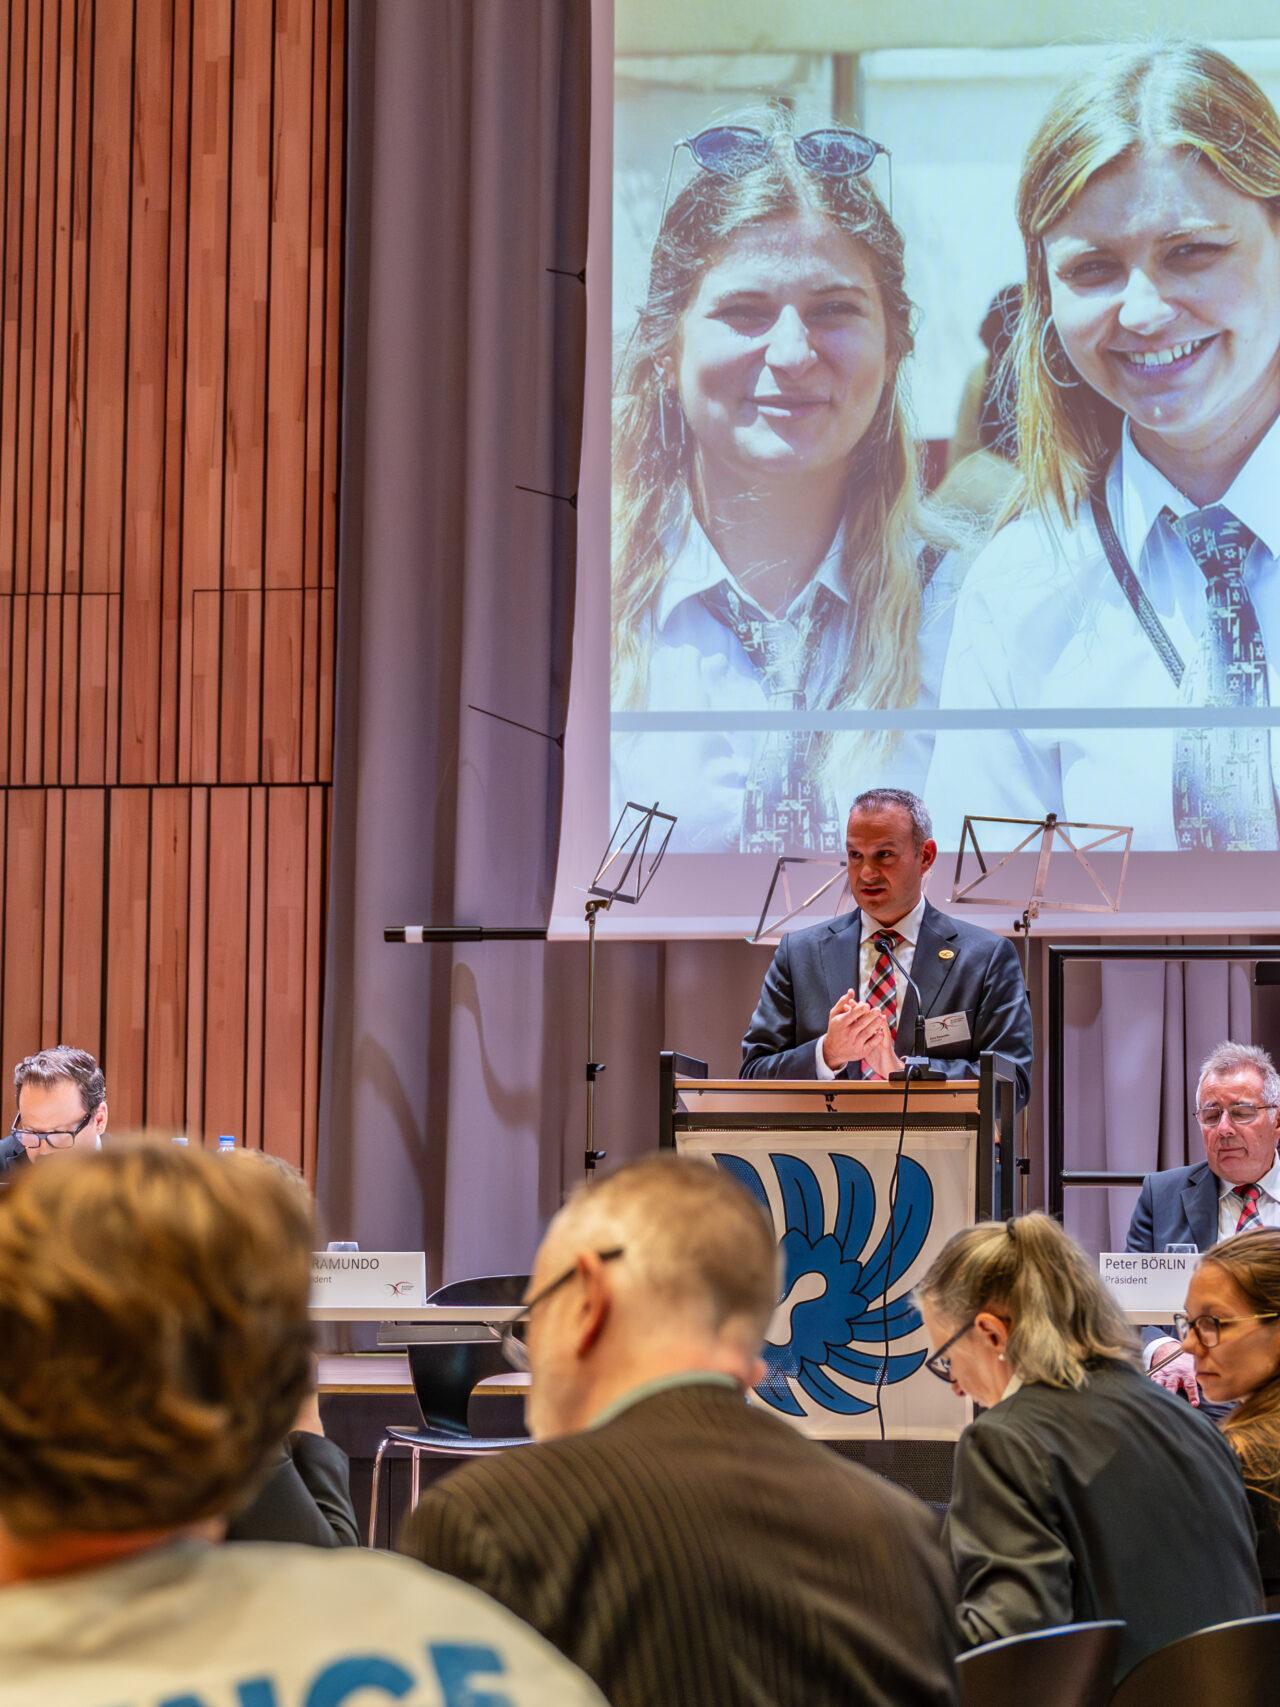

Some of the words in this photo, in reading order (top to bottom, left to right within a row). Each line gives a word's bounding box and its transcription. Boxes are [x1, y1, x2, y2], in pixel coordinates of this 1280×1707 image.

[1105, 1258, 1137, 1270] Peter
[1141, 1257, 1186, 1270] BÖRLIN
[1105, 1275, 1148, 1285] Präsident
